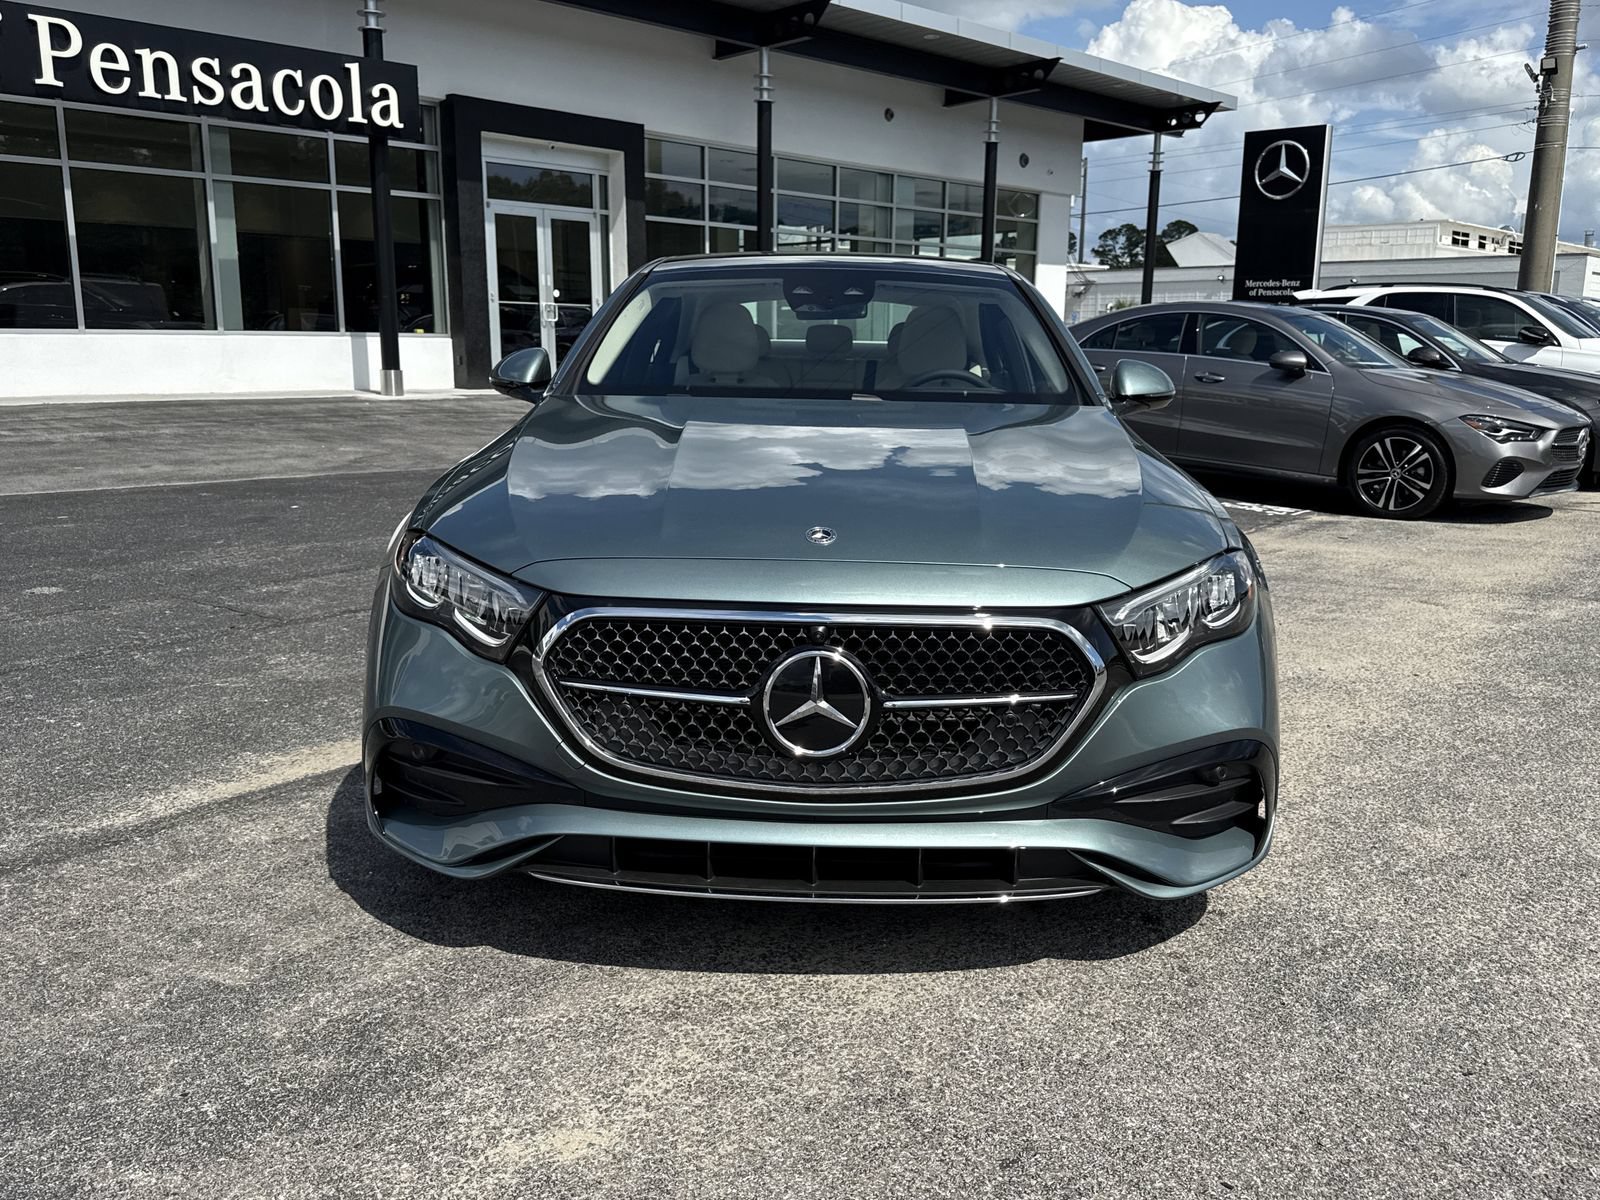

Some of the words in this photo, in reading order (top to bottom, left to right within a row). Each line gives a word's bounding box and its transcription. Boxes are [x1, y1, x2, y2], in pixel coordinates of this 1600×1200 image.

[27, 13, 404, 129] Pensacola
[1244, 279, 1301, 287] Mercedes-Benz
[1248, 288, 1258, 296] of
